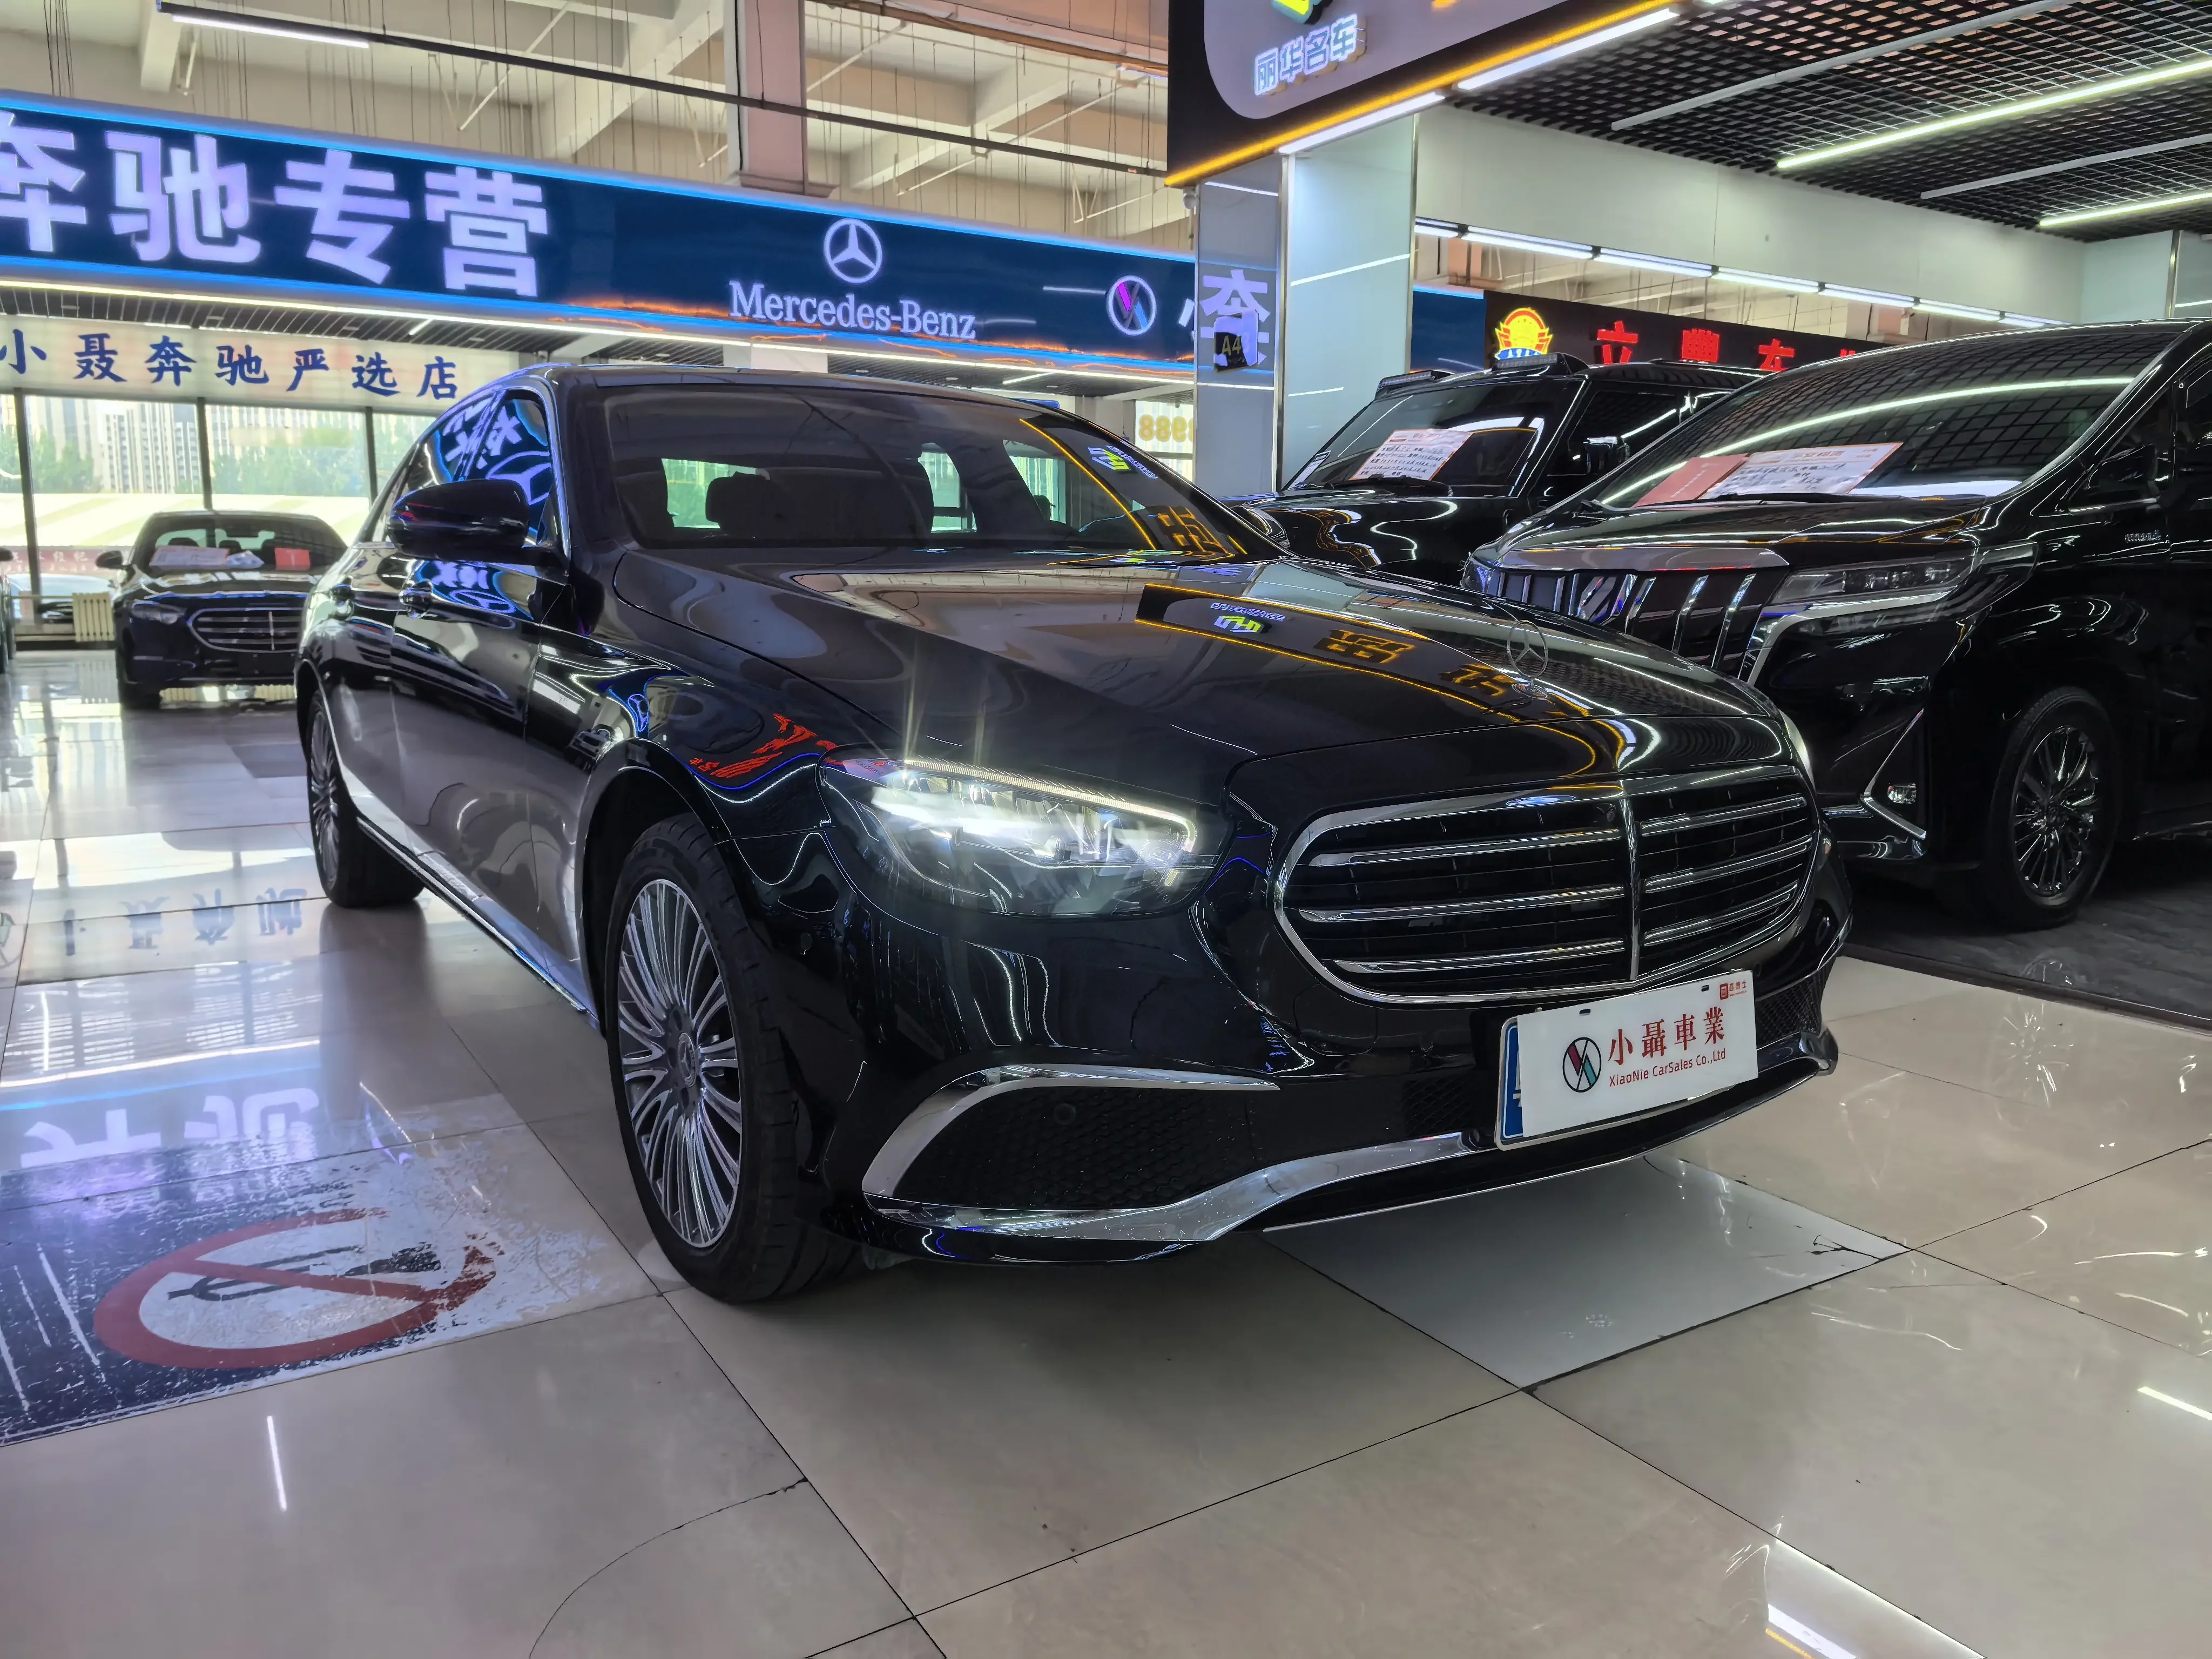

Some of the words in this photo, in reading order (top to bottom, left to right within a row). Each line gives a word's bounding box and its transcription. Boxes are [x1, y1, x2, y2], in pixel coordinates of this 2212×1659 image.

[1254, 13, 1358, 96] 丽华名车
[729, 280, 976, 339] Mercedes-Benz
[0, 328, 458, 400] 小聂奔驰严选店
[1608, 1006, 1725, 1065] 小聶車業
[1609, 1069, 1649, 1087] XiaoNie
[1653, 1058, 1693, 1077] CarSales
[1696, 1048, 1726, 1067] Co.,Ltd
